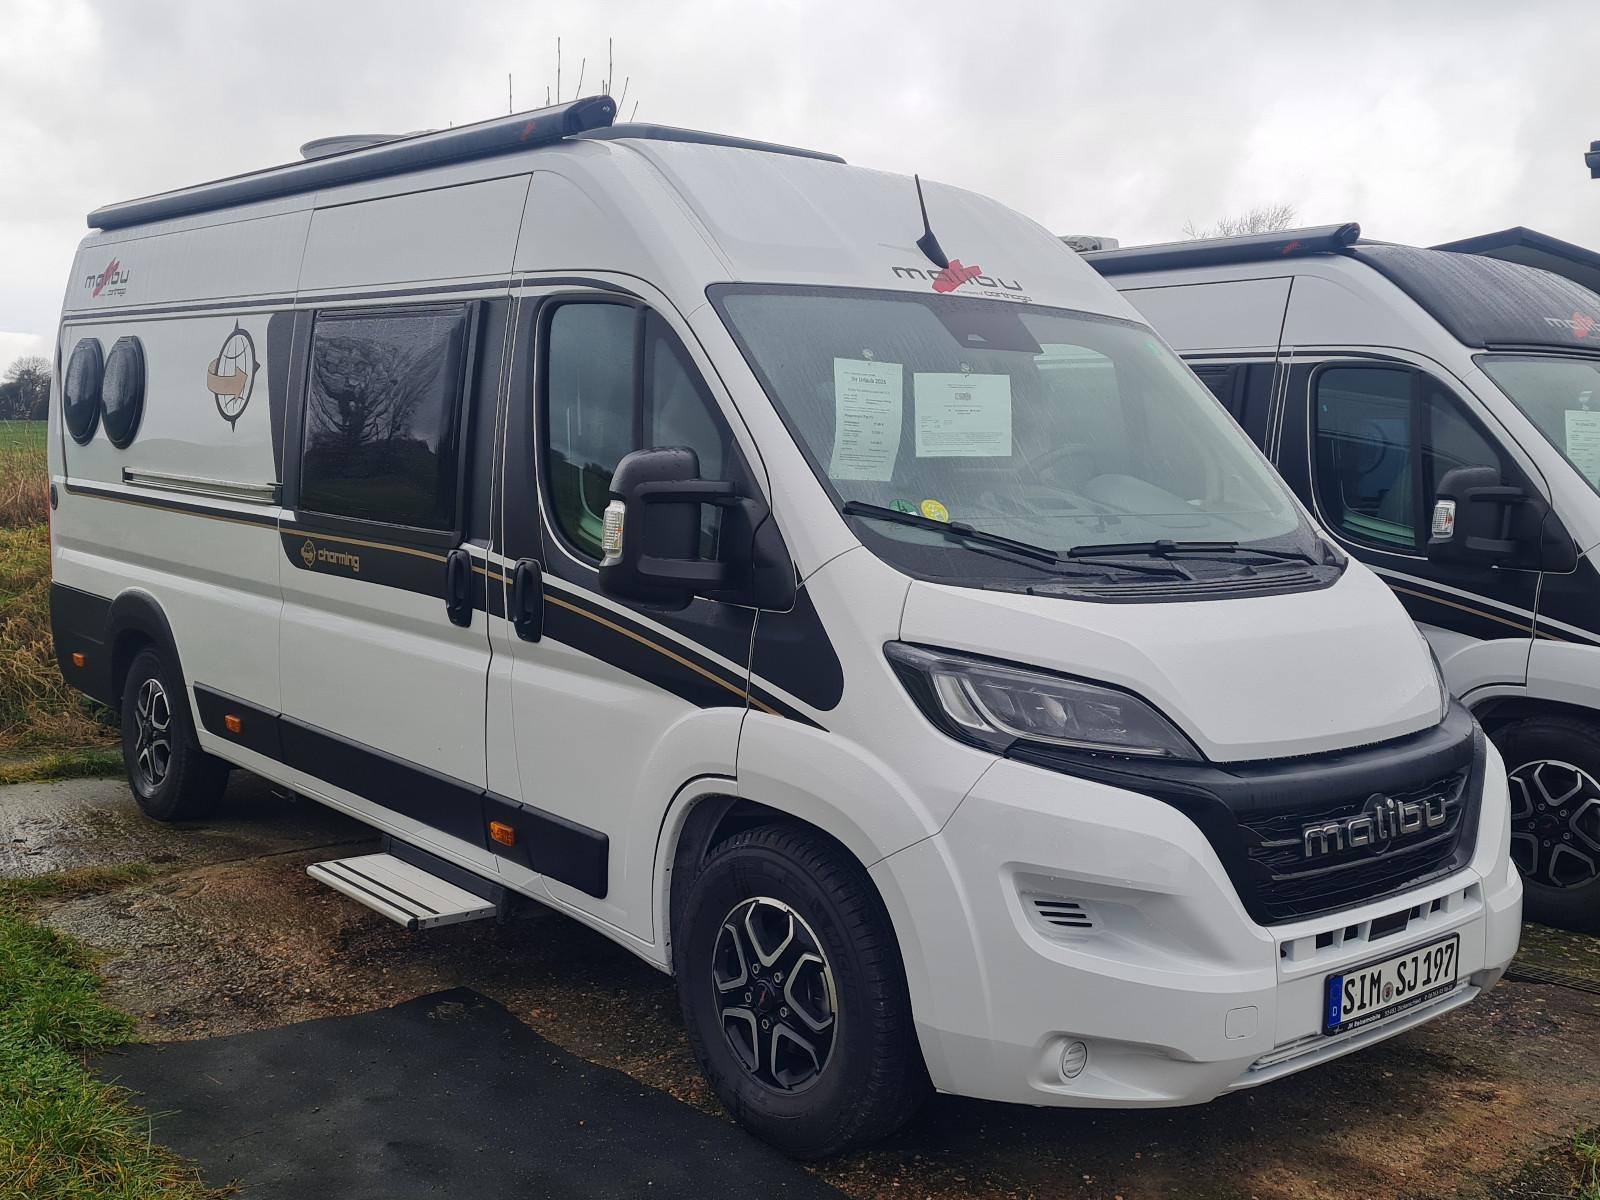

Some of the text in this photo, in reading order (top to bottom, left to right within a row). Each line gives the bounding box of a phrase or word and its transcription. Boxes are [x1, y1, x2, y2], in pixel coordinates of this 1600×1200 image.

[891, 264, 1023, 291] malibu
[318, 547, 360, 572] charming
[1304, 797, 1446, 857] malibu
[1342, 969, 1382, 1015] SIM
[1332, 1005, 1338, 1017] D
